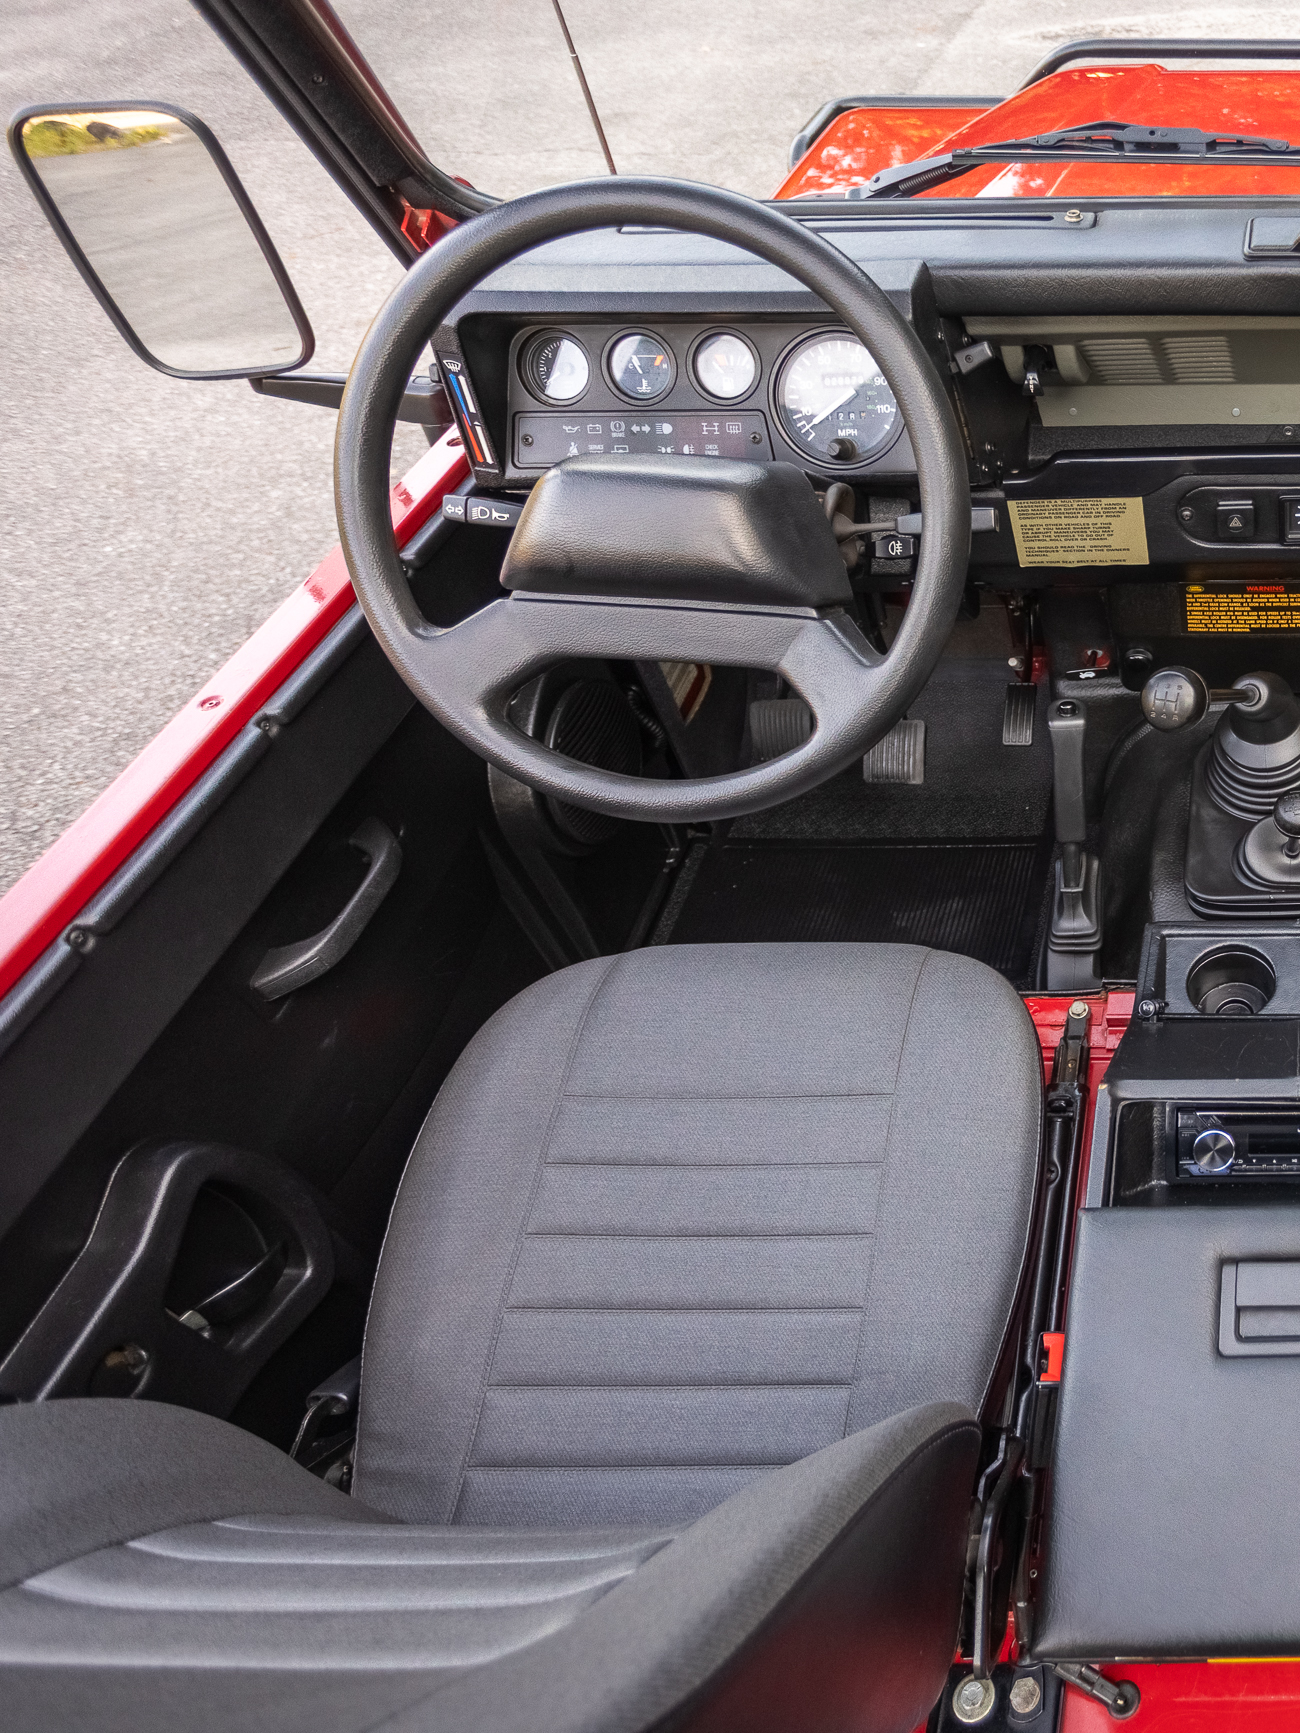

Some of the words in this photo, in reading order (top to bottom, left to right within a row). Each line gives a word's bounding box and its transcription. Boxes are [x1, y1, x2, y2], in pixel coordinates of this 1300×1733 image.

[818, 356, 831, 365] 50
[800, 380, 813, 389] 30
[874, 377, 887, 386] 90
[801, 407, 812, 416] 10
[876, 404, 891, 414] 110
